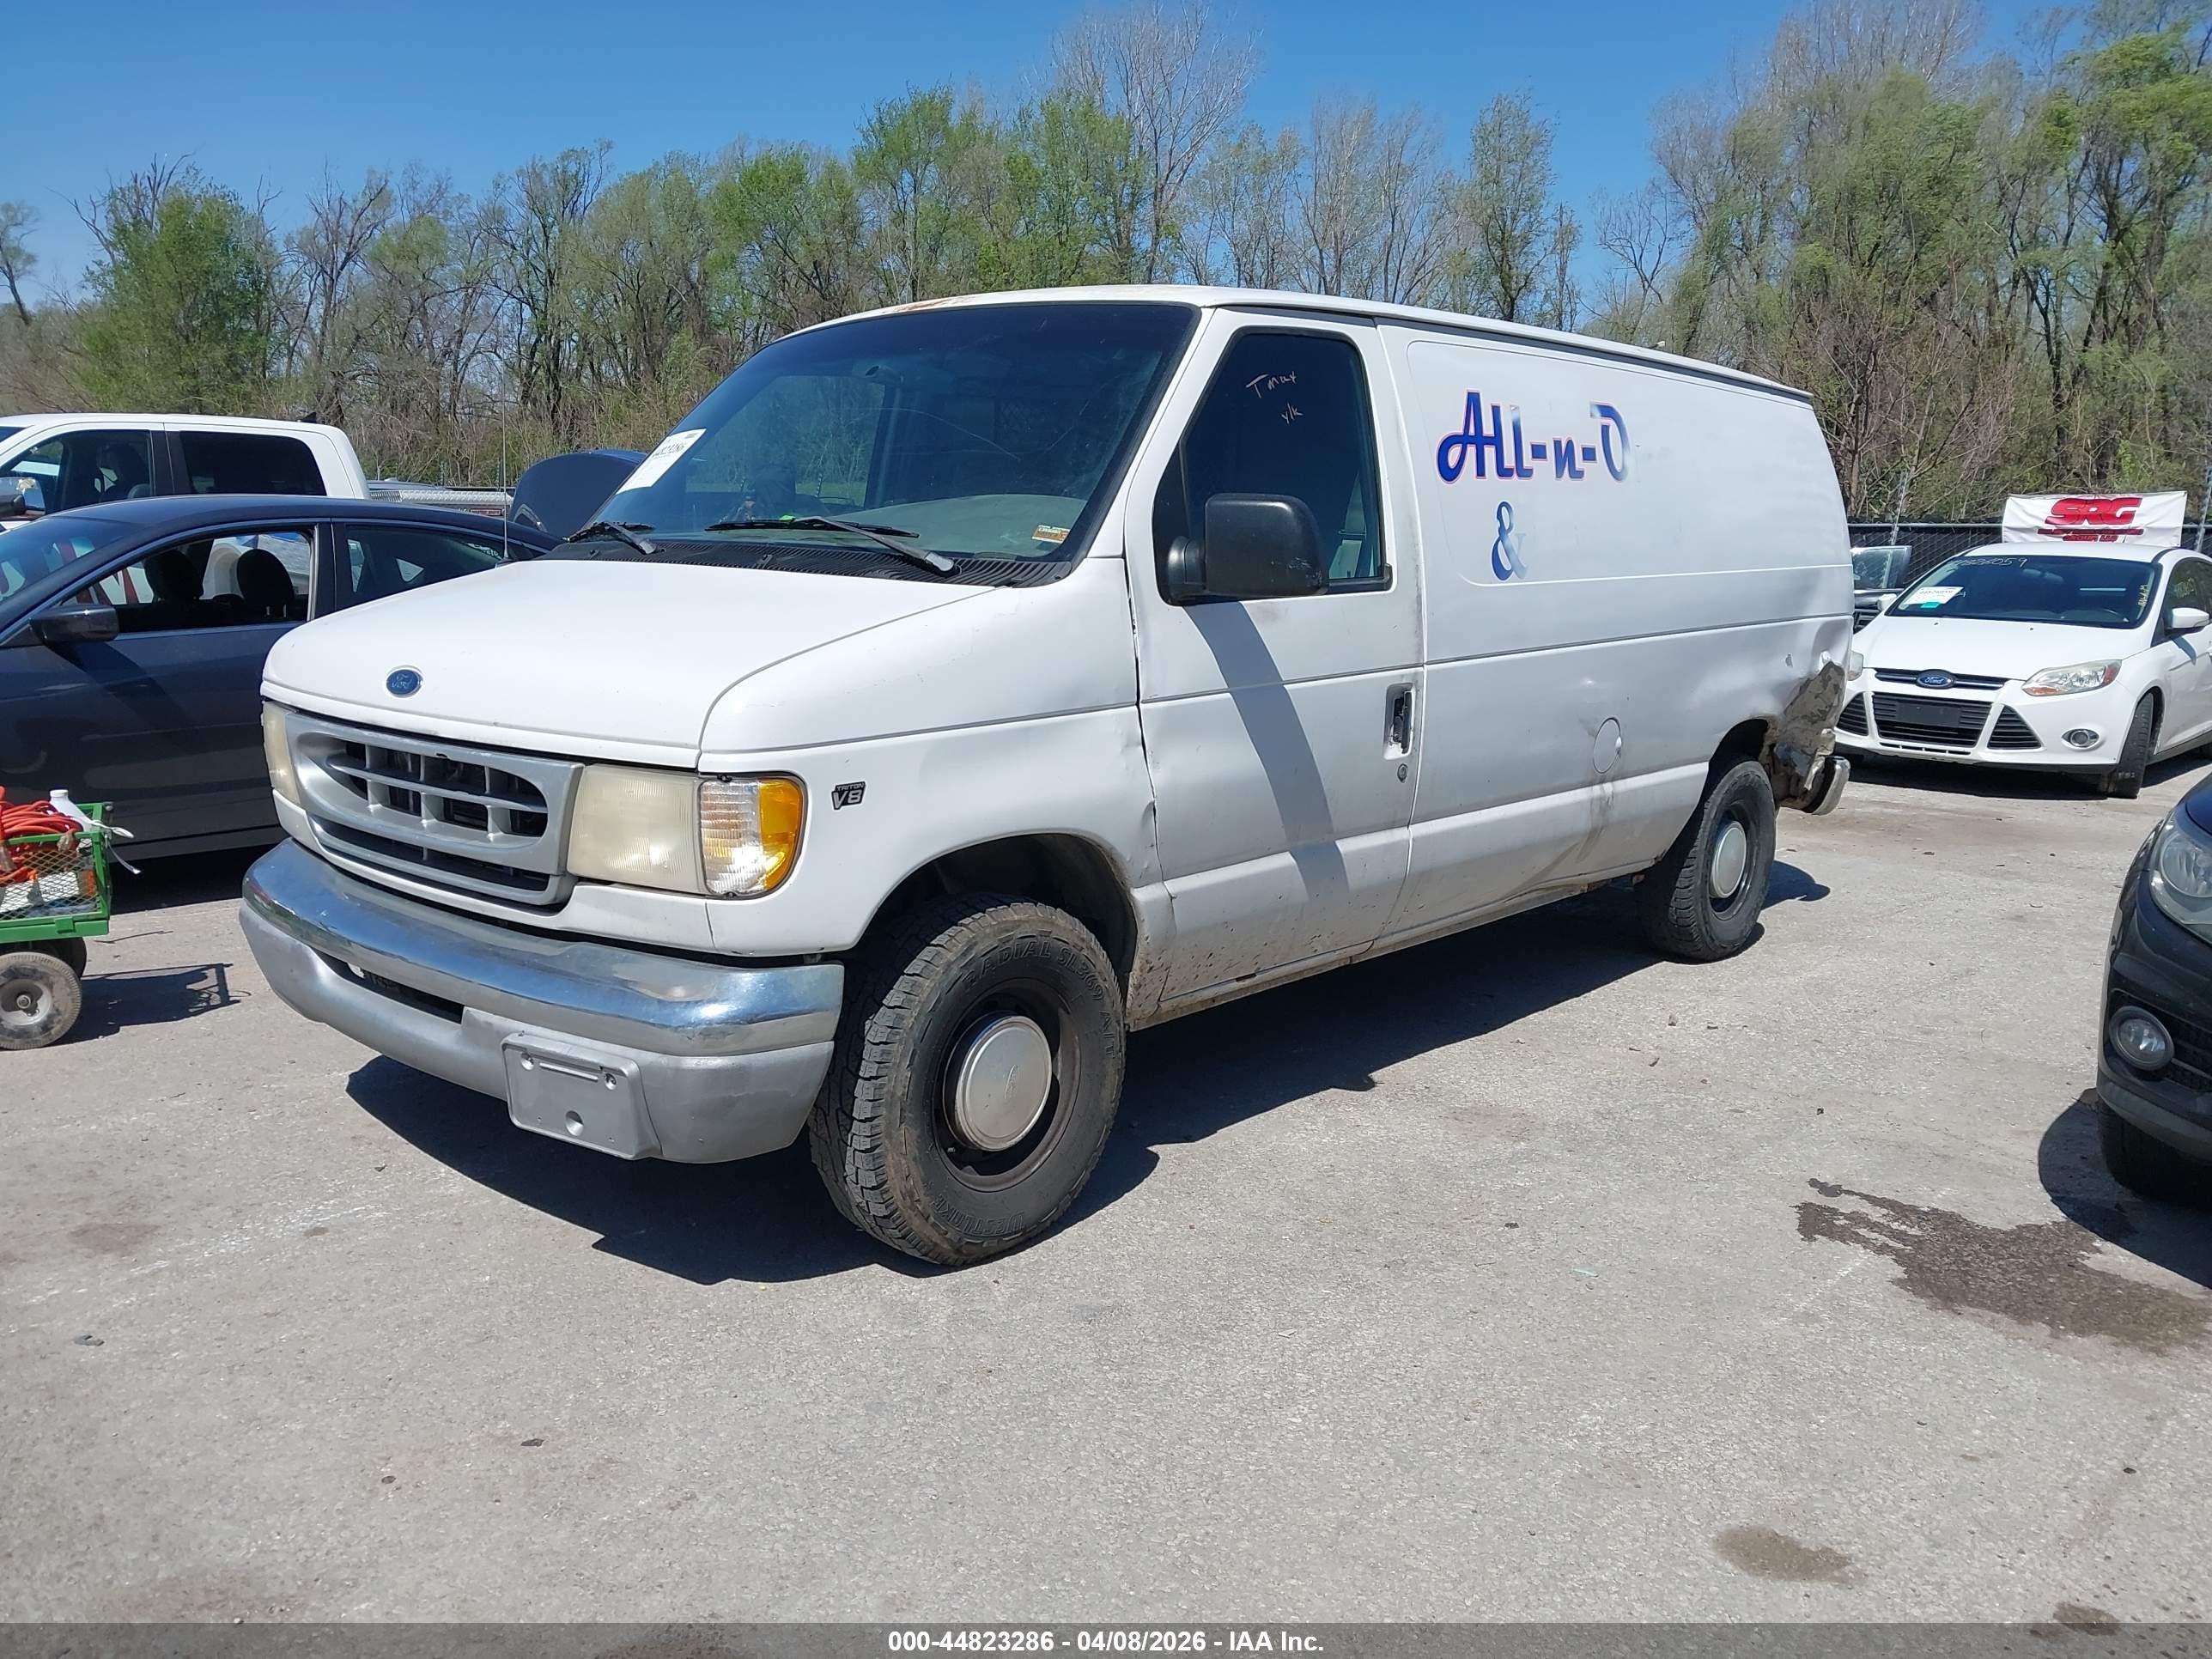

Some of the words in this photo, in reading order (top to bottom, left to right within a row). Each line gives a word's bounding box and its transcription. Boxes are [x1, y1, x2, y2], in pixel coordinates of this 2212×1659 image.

[2045, 497, 2142, 526] SRG
[1491, 501, 1528, 581] &
[836, 782, 865, 791] TRITON
[832, 789, 862, 809] V8
